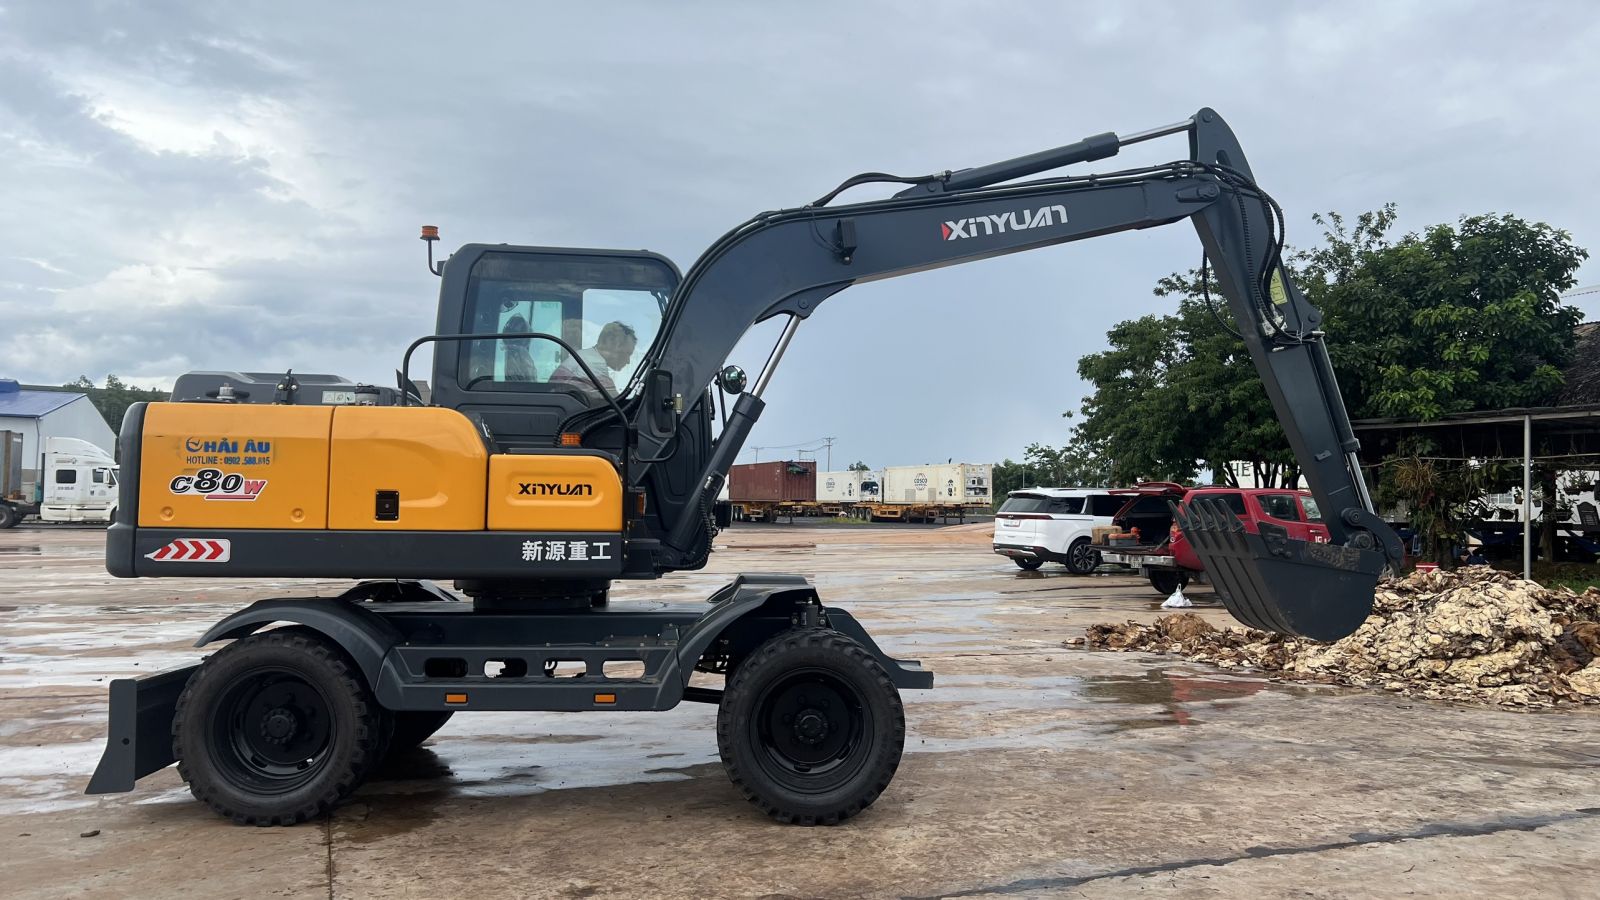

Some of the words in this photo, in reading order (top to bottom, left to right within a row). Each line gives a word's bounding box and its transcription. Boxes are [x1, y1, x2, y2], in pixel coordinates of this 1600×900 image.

[204, 437, 238, 453] HẢI
[244, 439, 270, 453] ÂU
[522, 540, 611, 561] 新源重工
